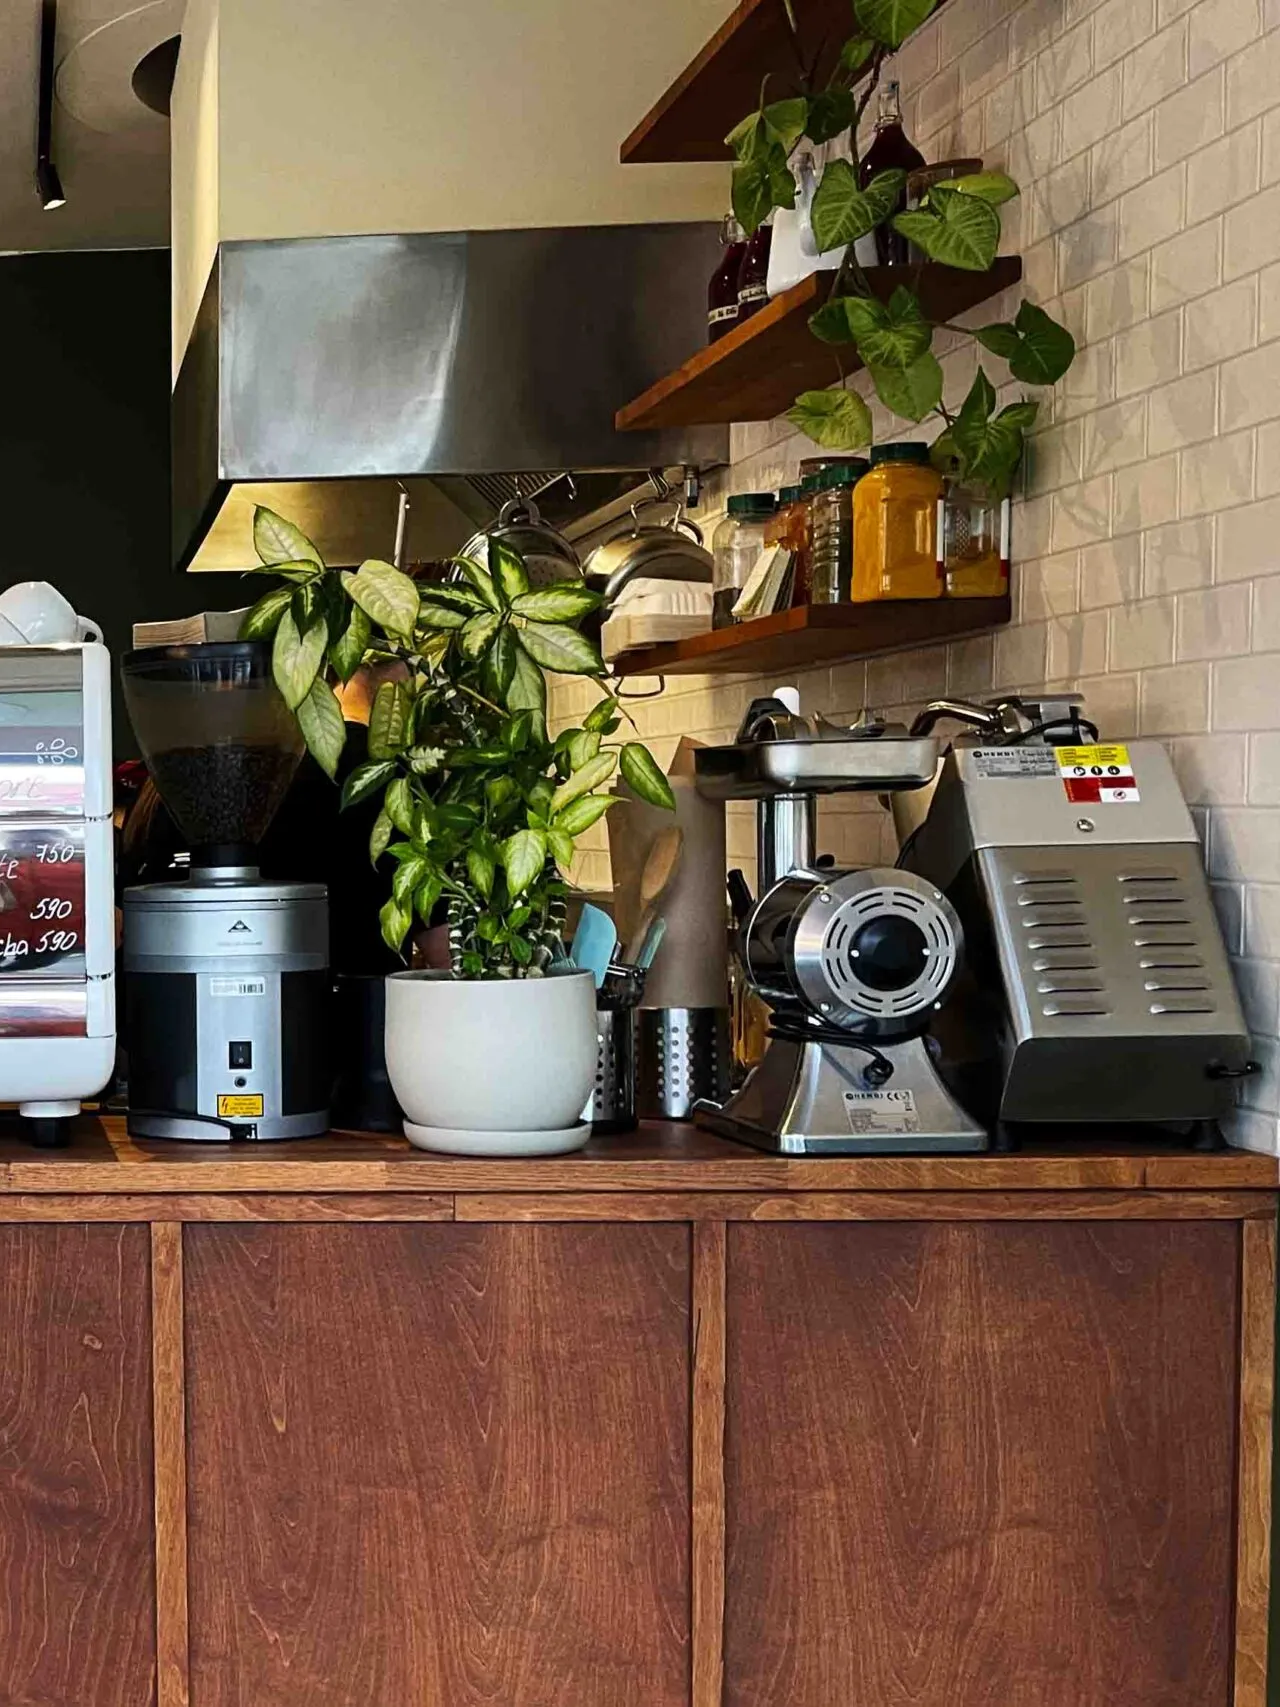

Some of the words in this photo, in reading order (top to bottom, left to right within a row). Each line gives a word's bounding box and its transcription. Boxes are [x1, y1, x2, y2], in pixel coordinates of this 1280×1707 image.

[35, 843, 75, 864] 750
[29, 898, 73, 920] 590
[35, 930, 78, 953] 590
